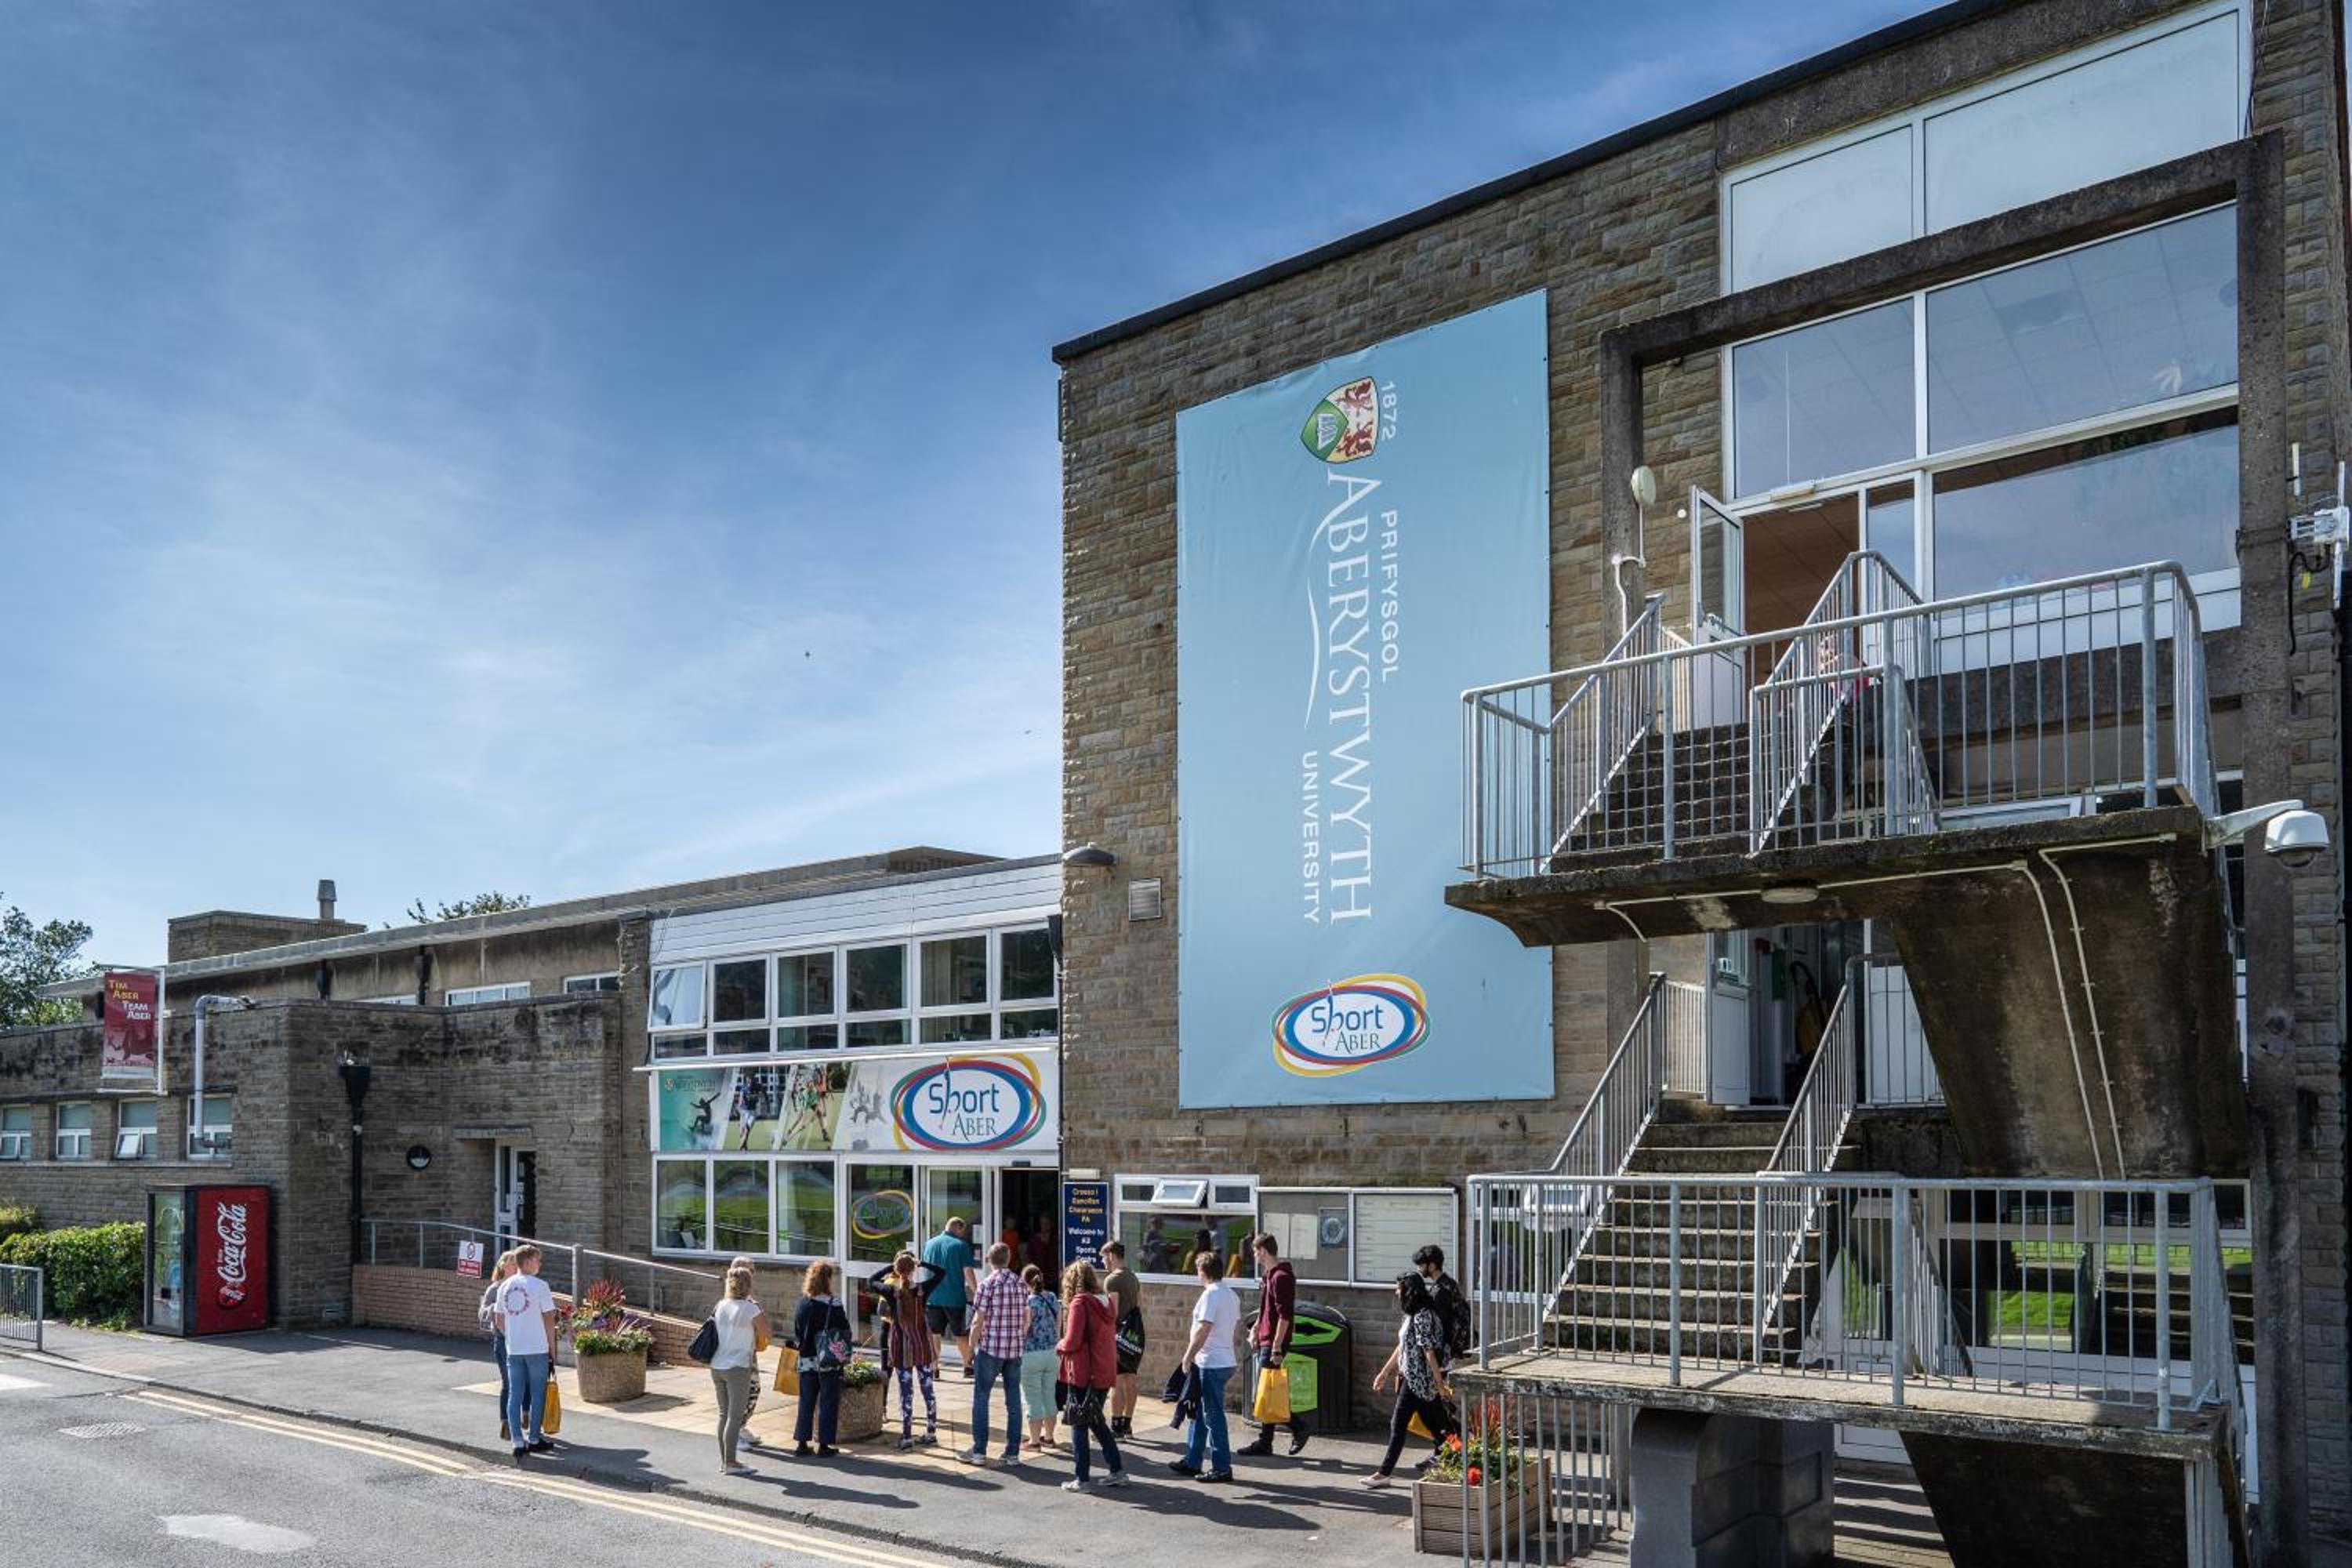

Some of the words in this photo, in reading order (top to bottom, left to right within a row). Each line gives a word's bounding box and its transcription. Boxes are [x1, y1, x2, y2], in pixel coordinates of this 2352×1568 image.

[1380, 381, 1397, 439] 1872
[1381, 510, 1398, 683] PRIFYSGOL
[1311, 468, 1381, 924] ABERYSTWYTH
[1302, 750, 1319, 924] UNIVERSITY
[108, 980, 128, 989] TIM
[113, 990, 139, 1000] ABER
[122, 1001, 148, 1011] TEAM
[127, 1011, 151, 1020] ABER
[1334, 1032, 1381, 1054] ABER
[953, 1113, 998, 1142] ABER
[217, 1202, 247, 1283] Coca-Cola
